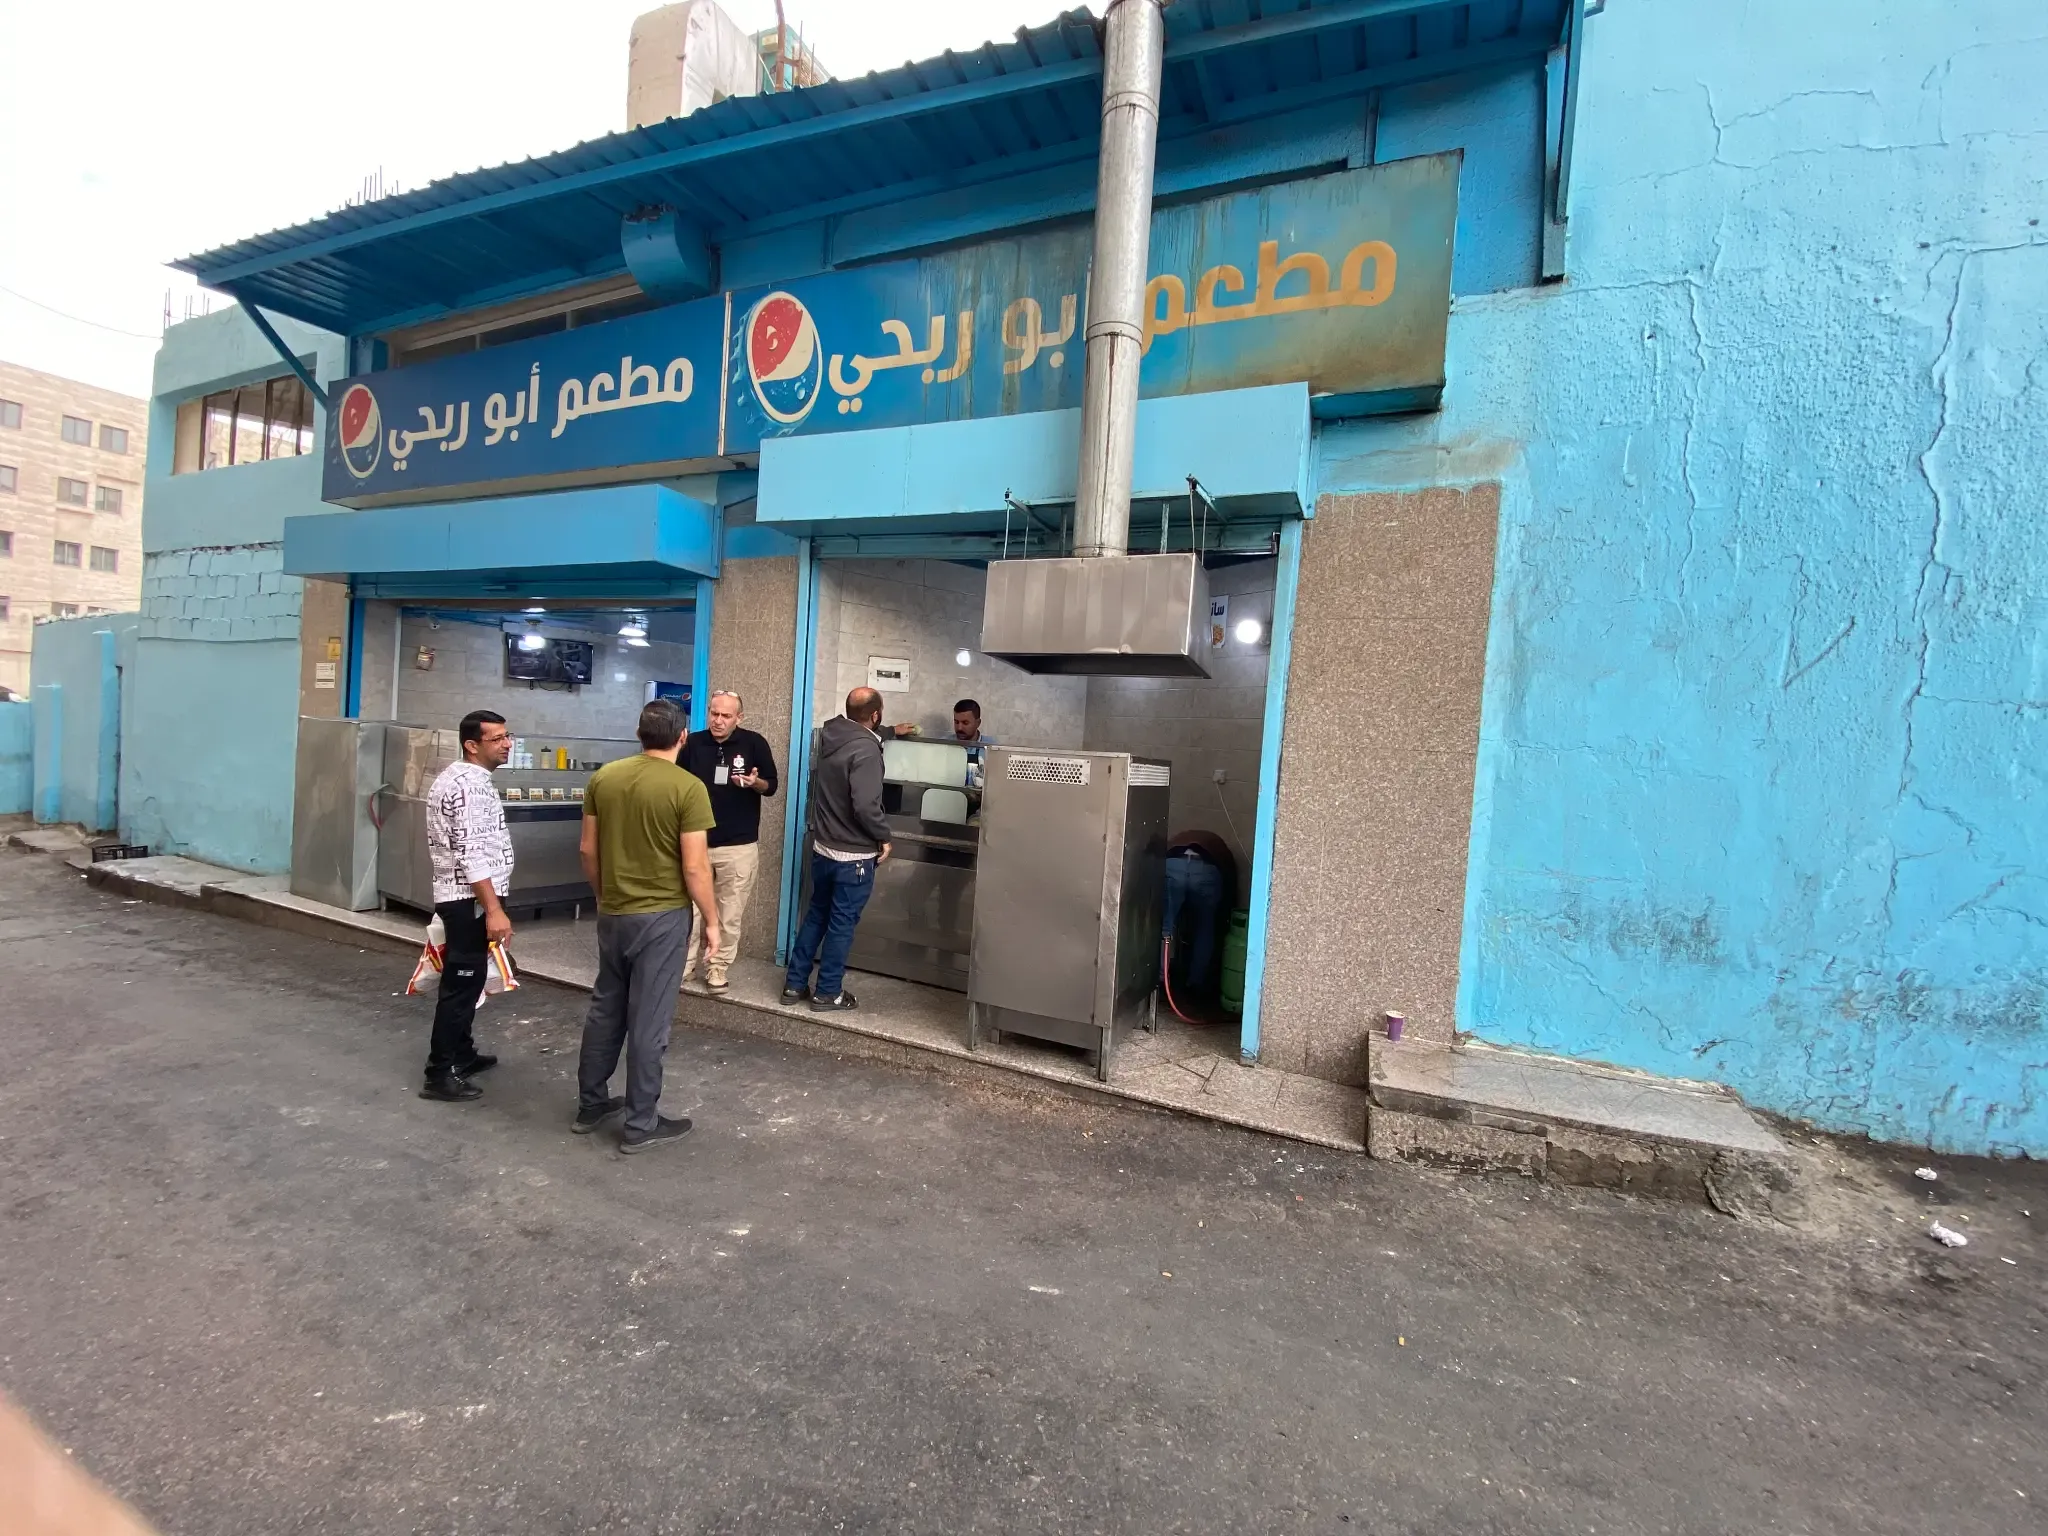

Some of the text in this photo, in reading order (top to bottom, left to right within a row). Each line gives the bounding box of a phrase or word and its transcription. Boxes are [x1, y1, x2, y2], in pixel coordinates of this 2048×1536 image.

[829, 241, 1397, 415] مطعم بو ربحي
[388, 356, 694, 472] مطعم أبو ربحي
